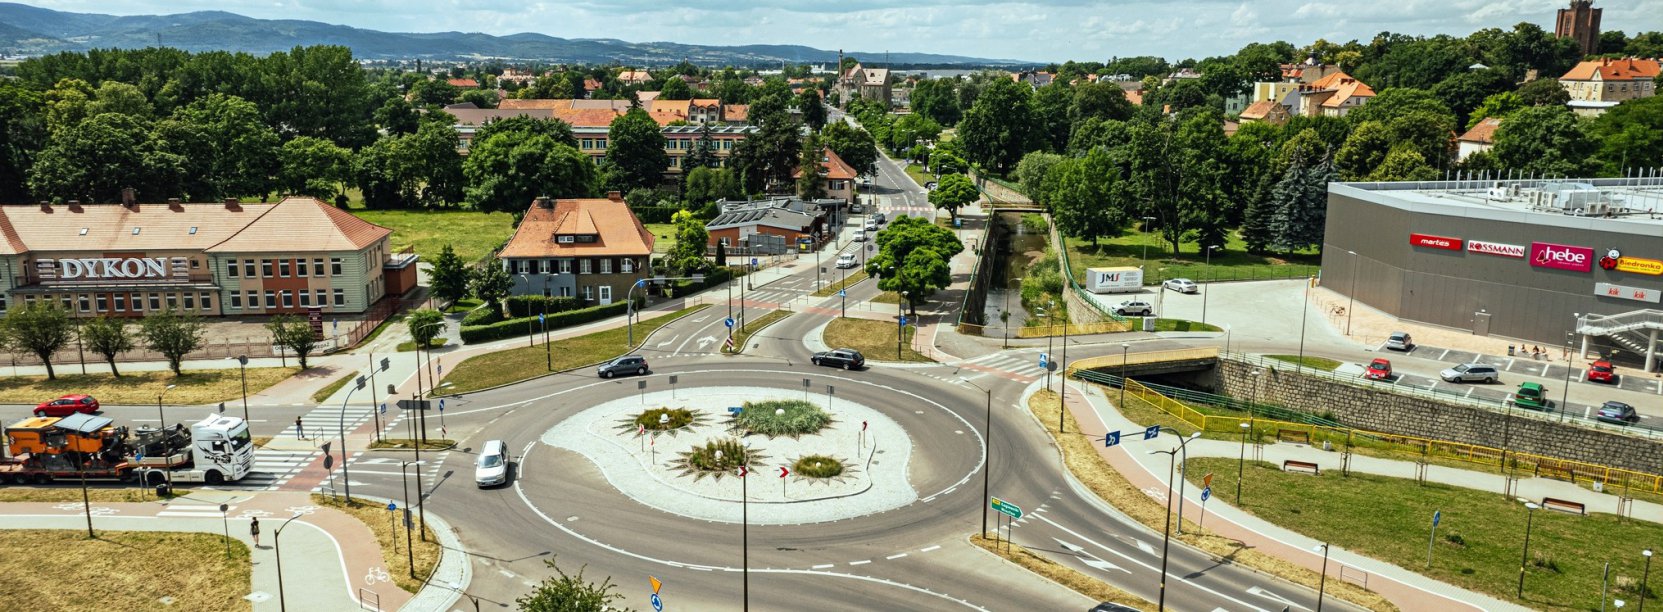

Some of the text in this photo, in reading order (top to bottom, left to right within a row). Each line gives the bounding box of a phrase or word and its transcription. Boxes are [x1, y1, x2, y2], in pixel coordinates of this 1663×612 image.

[1420, 238, 1451, 247] martes
[1469, 242, 1524, 255] ROSSMANN
[1545, 246, 1586, 263] hebe
[58, 257, 168, 279] DYKON
[1619, 259, 1661, 270] Biedronka
[1100, 273, 1120, 283] JMS
